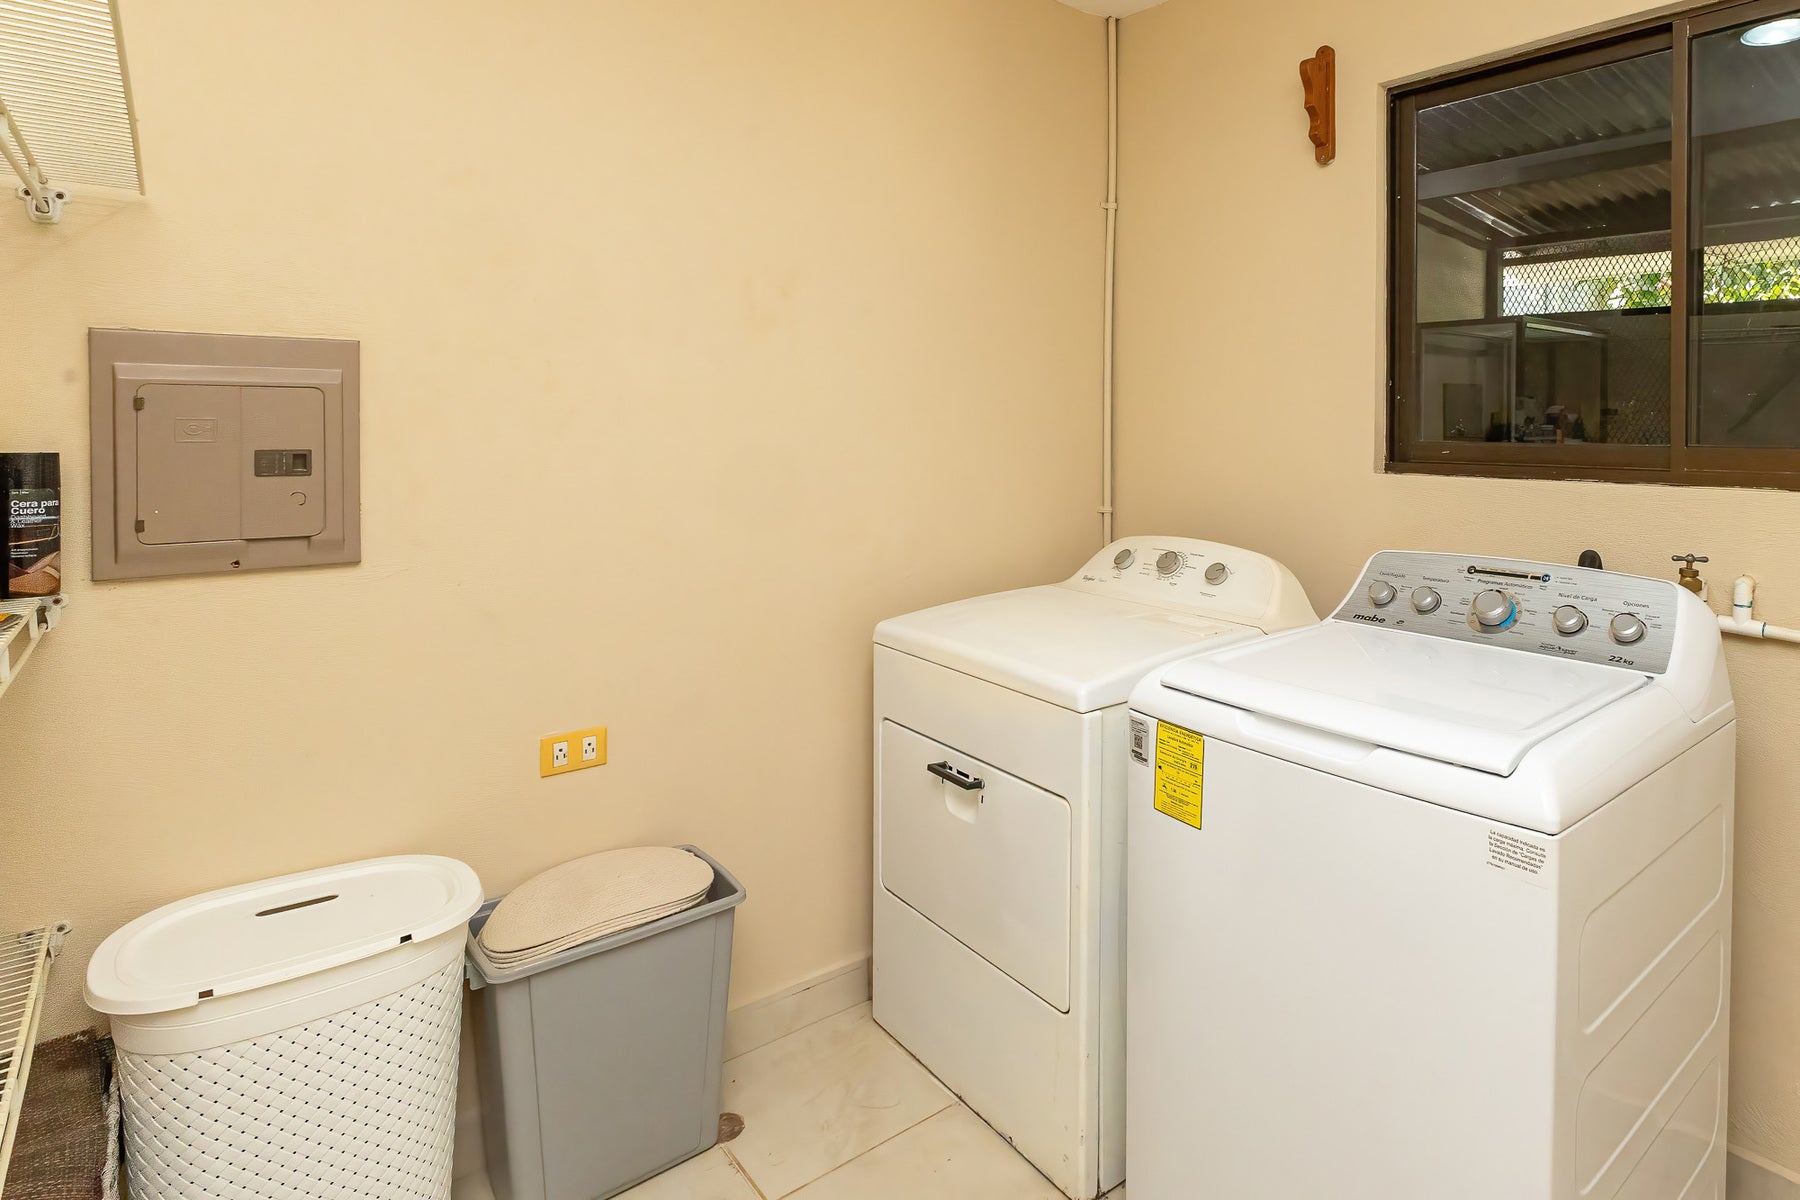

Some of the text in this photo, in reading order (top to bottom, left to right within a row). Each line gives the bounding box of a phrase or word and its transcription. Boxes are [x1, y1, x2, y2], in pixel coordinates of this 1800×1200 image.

[11, 500, 38, 508] Cera
[1623, 600, 1650, 608] Opciones
[1353, 613, 1386, 624] mabe
[1608, 655, 1623, 664] 22
